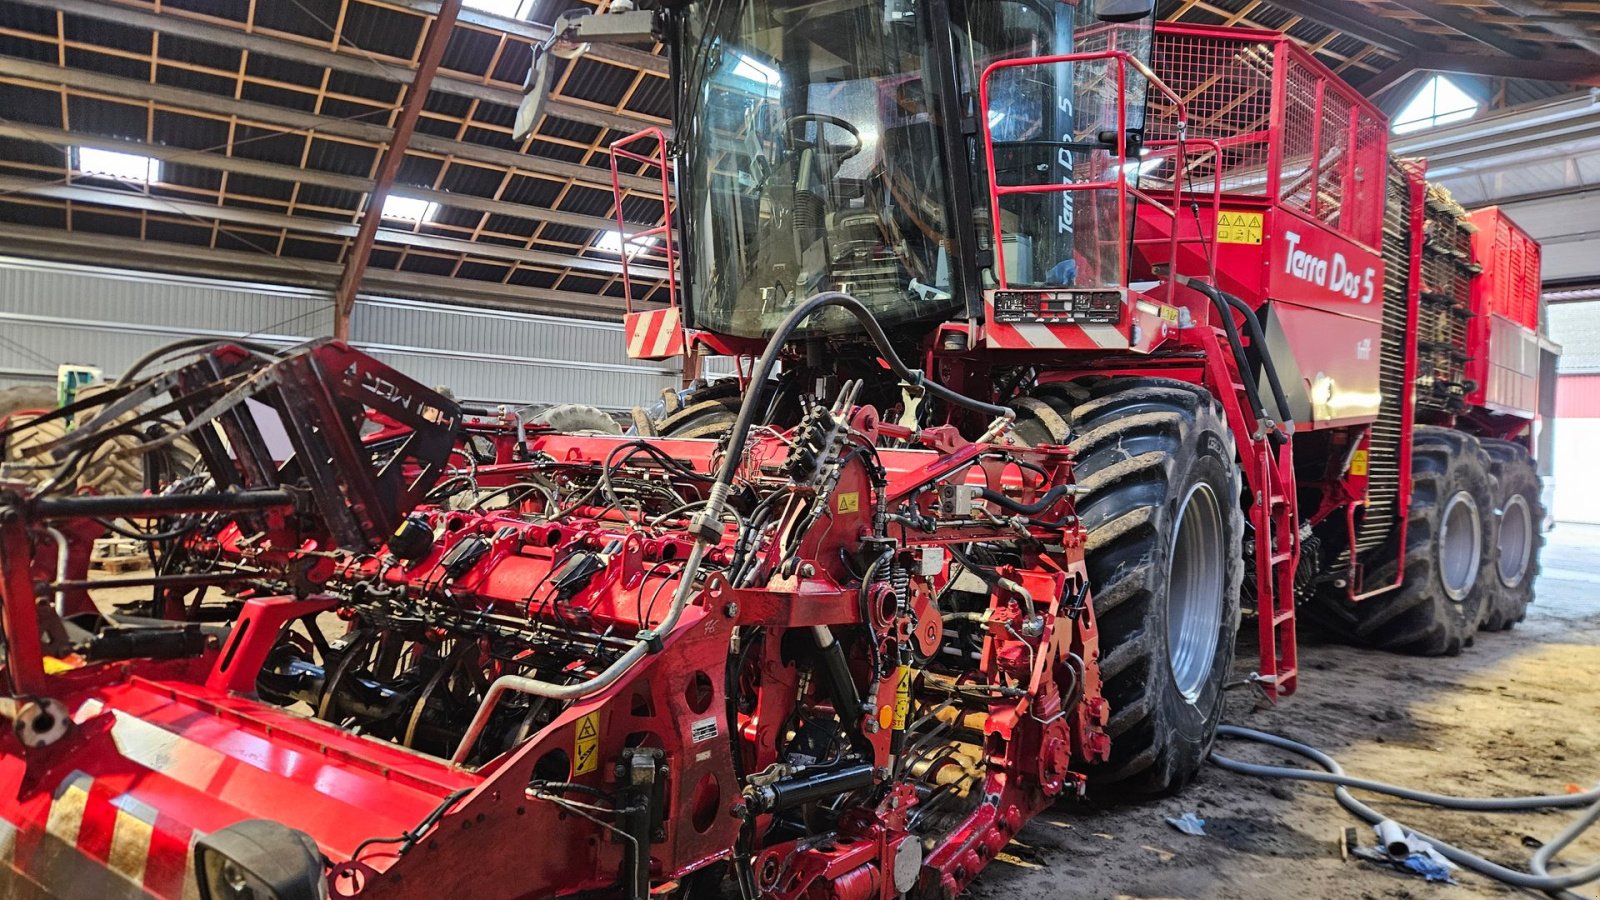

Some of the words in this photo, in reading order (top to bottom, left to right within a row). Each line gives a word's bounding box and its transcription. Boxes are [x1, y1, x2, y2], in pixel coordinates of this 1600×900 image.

[1059, 96, 1073, 117] 5
[1284, 230, 1328, 287] Terra
[1329, 252, 1361, 299] Dos
[1361, 267, 1376, 304] 5
